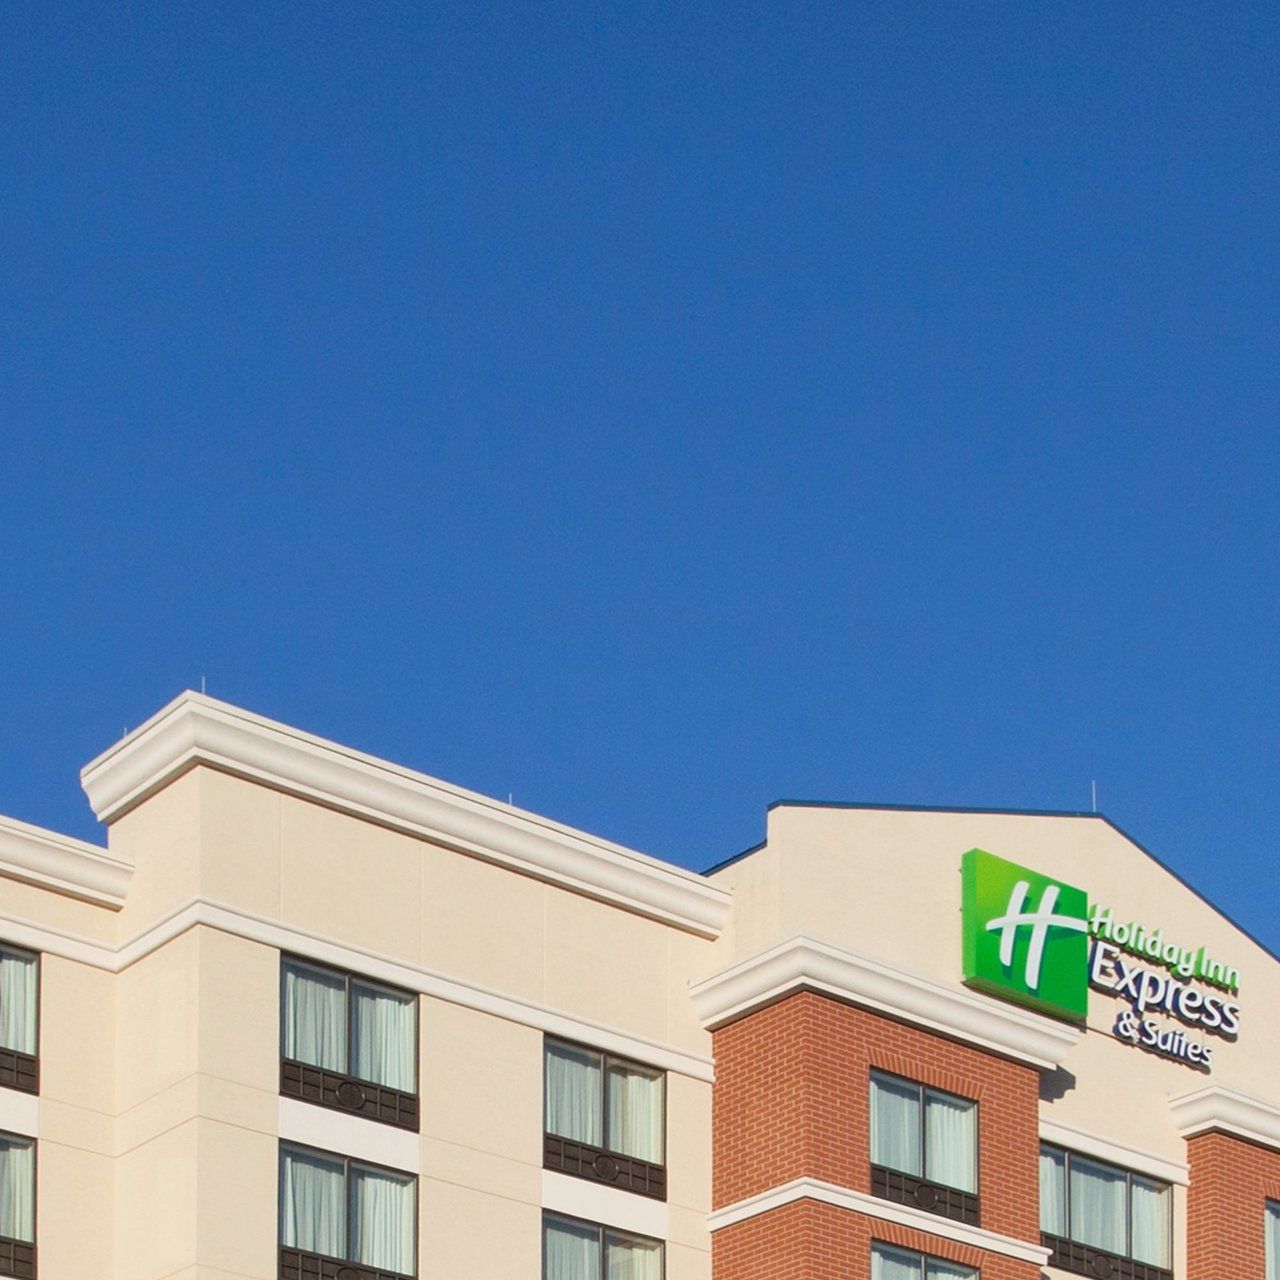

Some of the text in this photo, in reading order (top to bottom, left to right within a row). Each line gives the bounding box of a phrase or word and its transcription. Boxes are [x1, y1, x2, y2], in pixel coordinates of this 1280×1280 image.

[1088, 903, 1240, 989] Holiday Inn
[1091, 940, 1241, 1034] Express
[1118, 1010, 1213, 1066] & Suites
